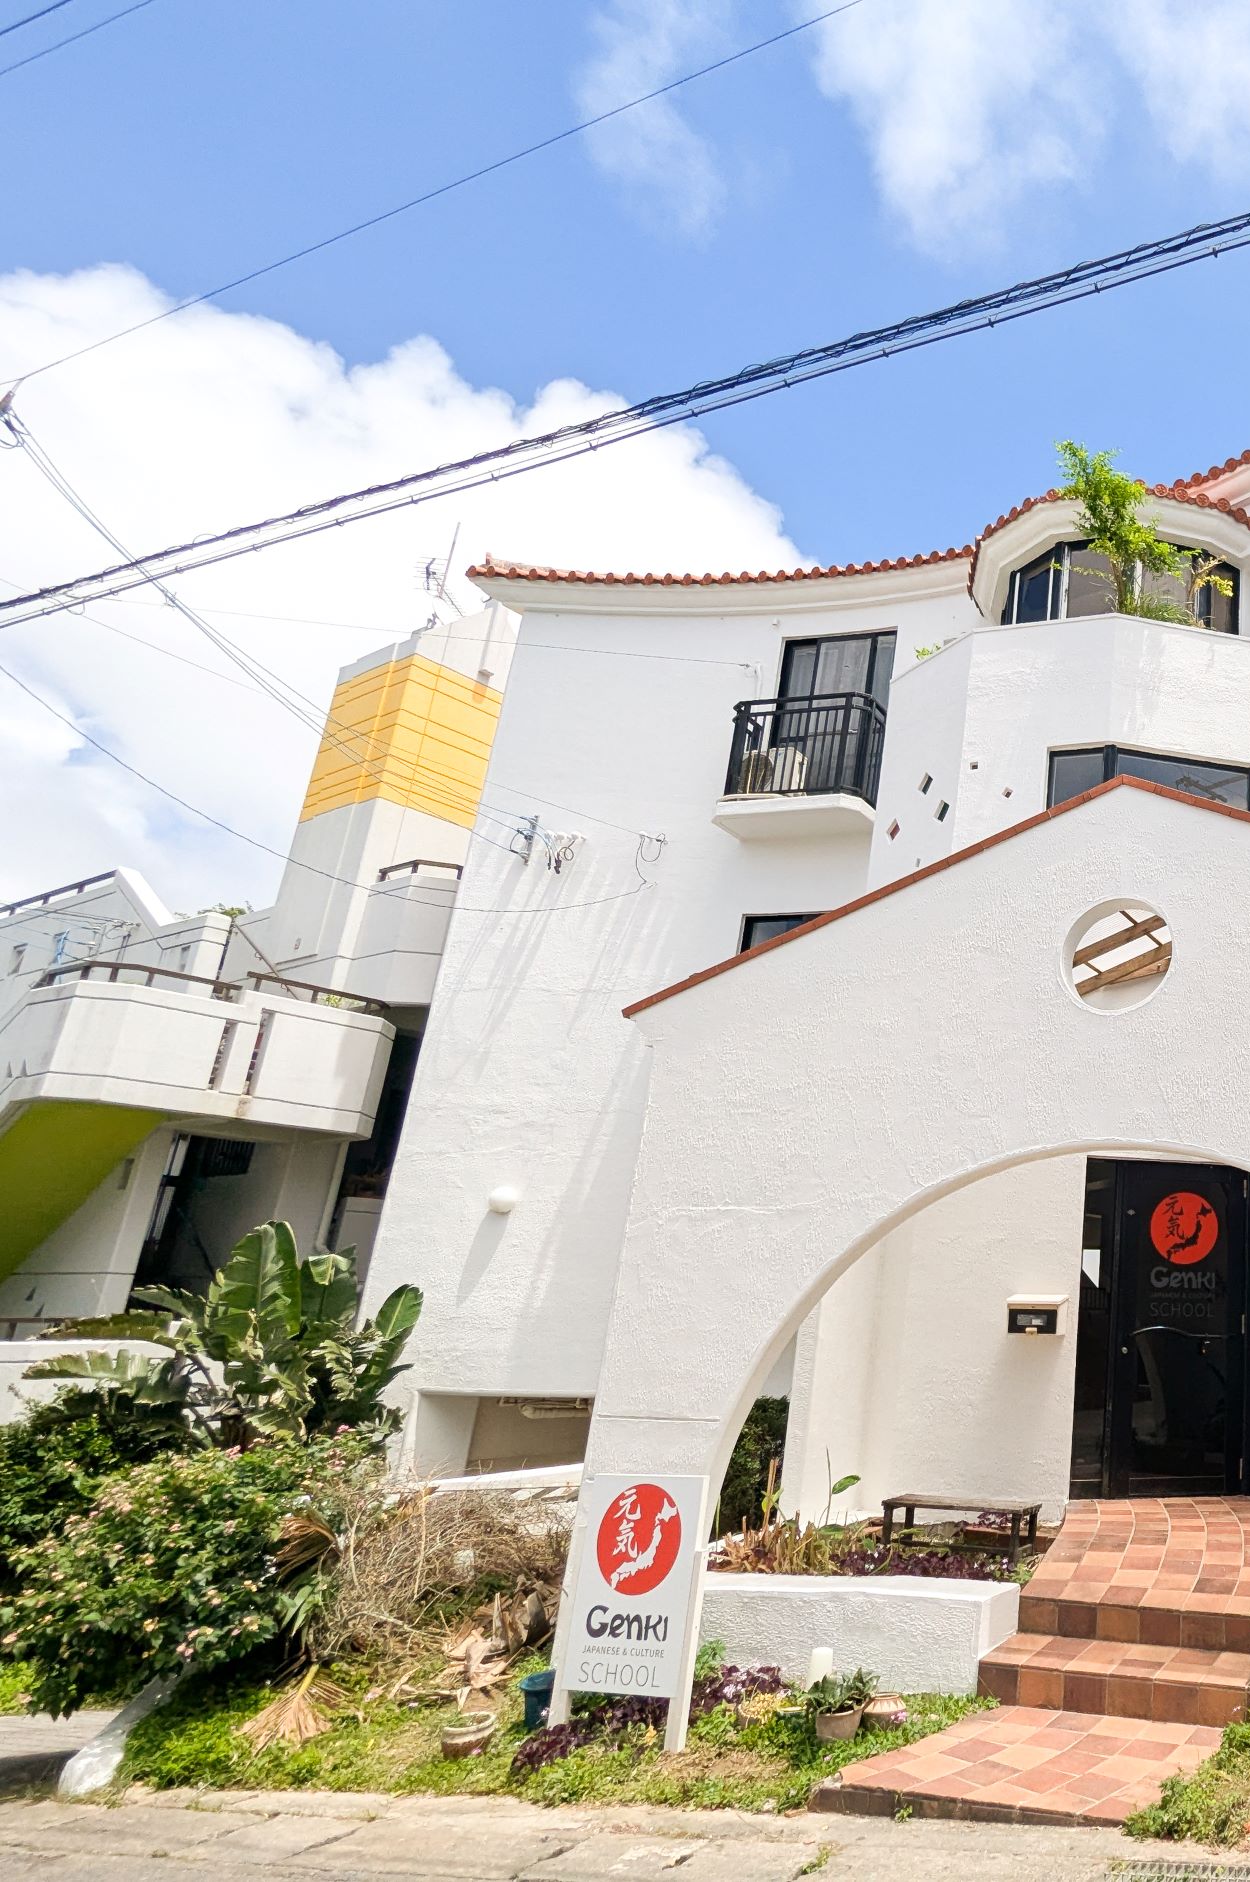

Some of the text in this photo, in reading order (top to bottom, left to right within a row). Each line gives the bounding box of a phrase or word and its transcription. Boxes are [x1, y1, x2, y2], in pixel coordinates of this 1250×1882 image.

[1162, 1196, 1185, 1240] 元気
[1150, 1302, 1214, 1317] SCHOOL
[612, 1488, 641, 1558] 元気
[582, 1645, 665, 1659] JAPANESE & CULTURE
[578, 1661, 661, 1688] SCHOOL
